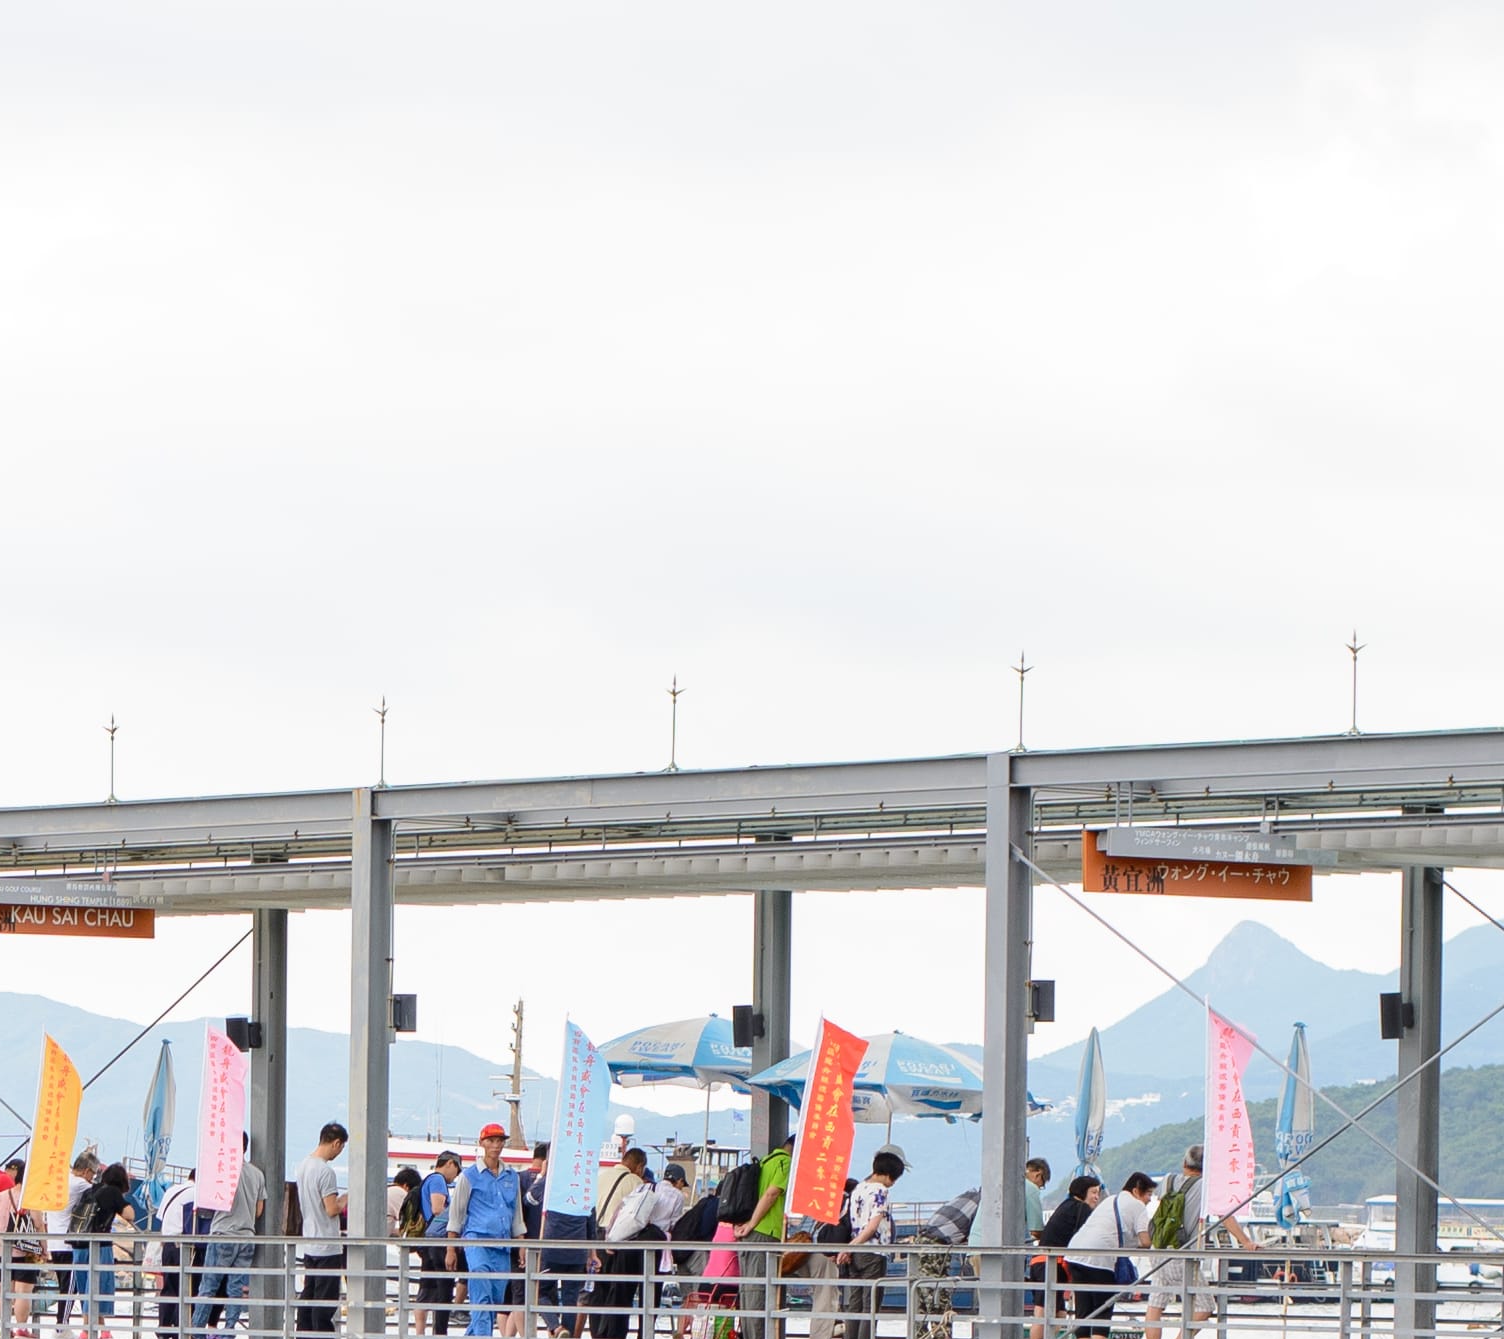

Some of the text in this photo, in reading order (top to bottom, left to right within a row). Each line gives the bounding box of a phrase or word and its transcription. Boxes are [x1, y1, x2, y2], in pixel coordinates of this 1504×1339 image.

[1157, 862, 1291, 885] ウォング・イー・チャウ
[11, 906, 134, 928] KAU SAI CHAU
[897, 1060, 956, 1071] POCARI
[808, 1072, 844, 1211] 盛會在西貢二零一八
